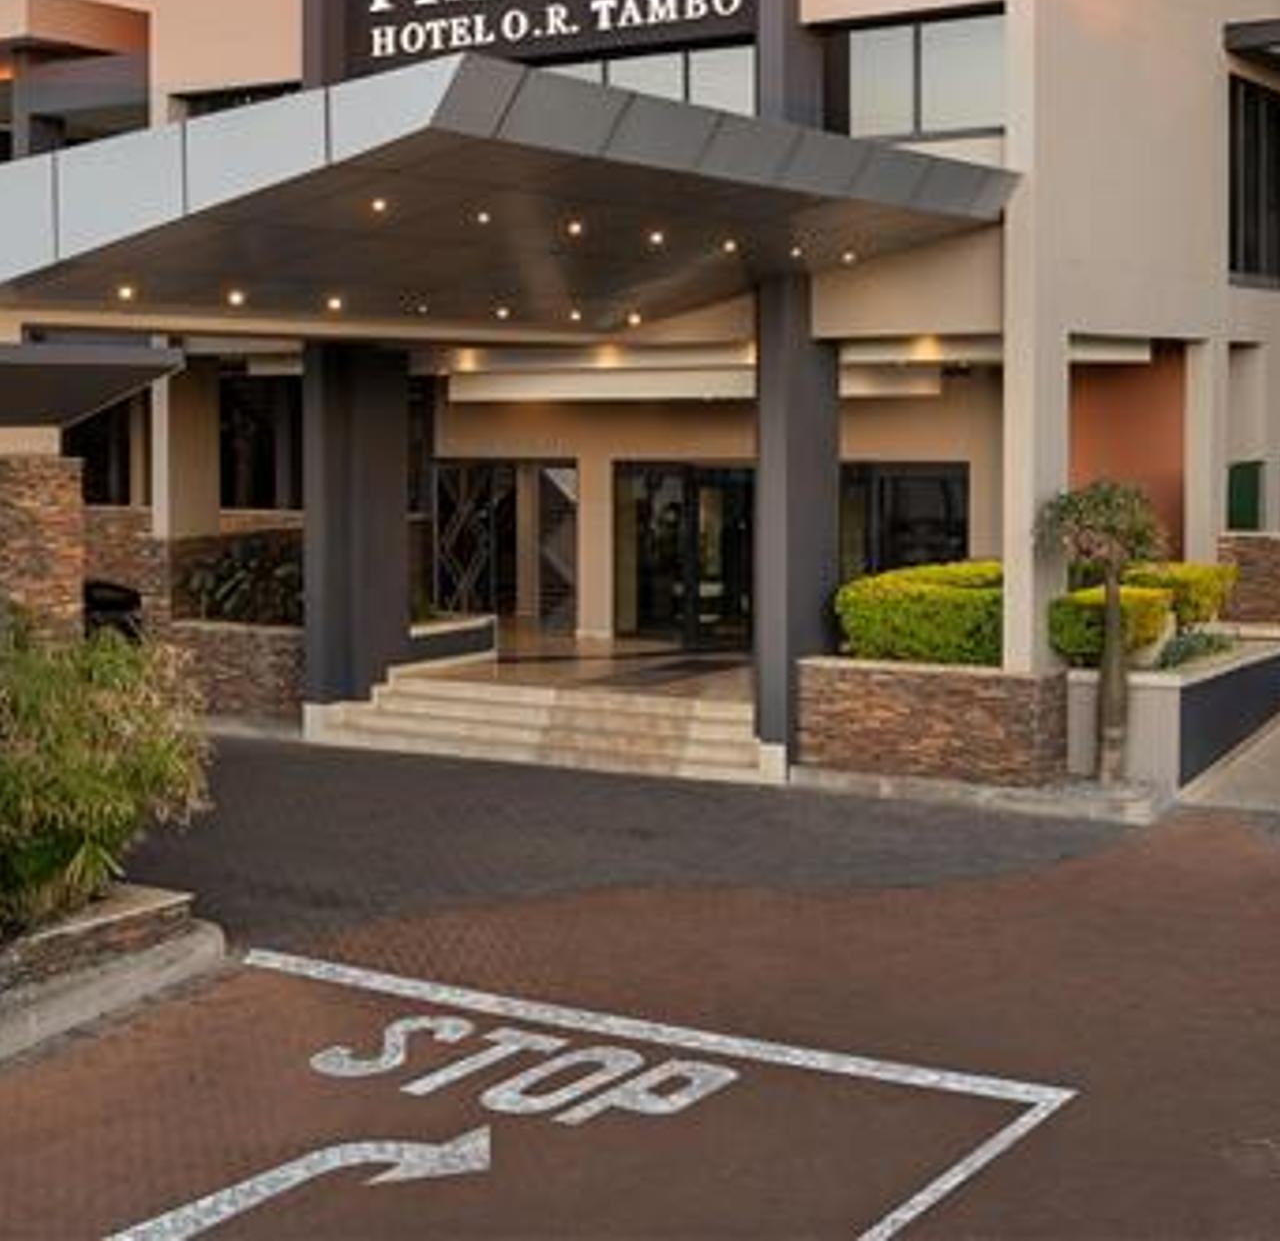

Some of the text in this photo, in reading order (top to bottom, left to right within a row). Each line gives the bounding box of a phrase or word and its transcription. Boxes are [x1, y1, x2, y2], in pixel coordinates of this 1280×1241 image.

[371, 15, 496, 57] HOTEL
[501, 5, 580, 41] O.R.
[309, 1016, 739, 1125] STOP
